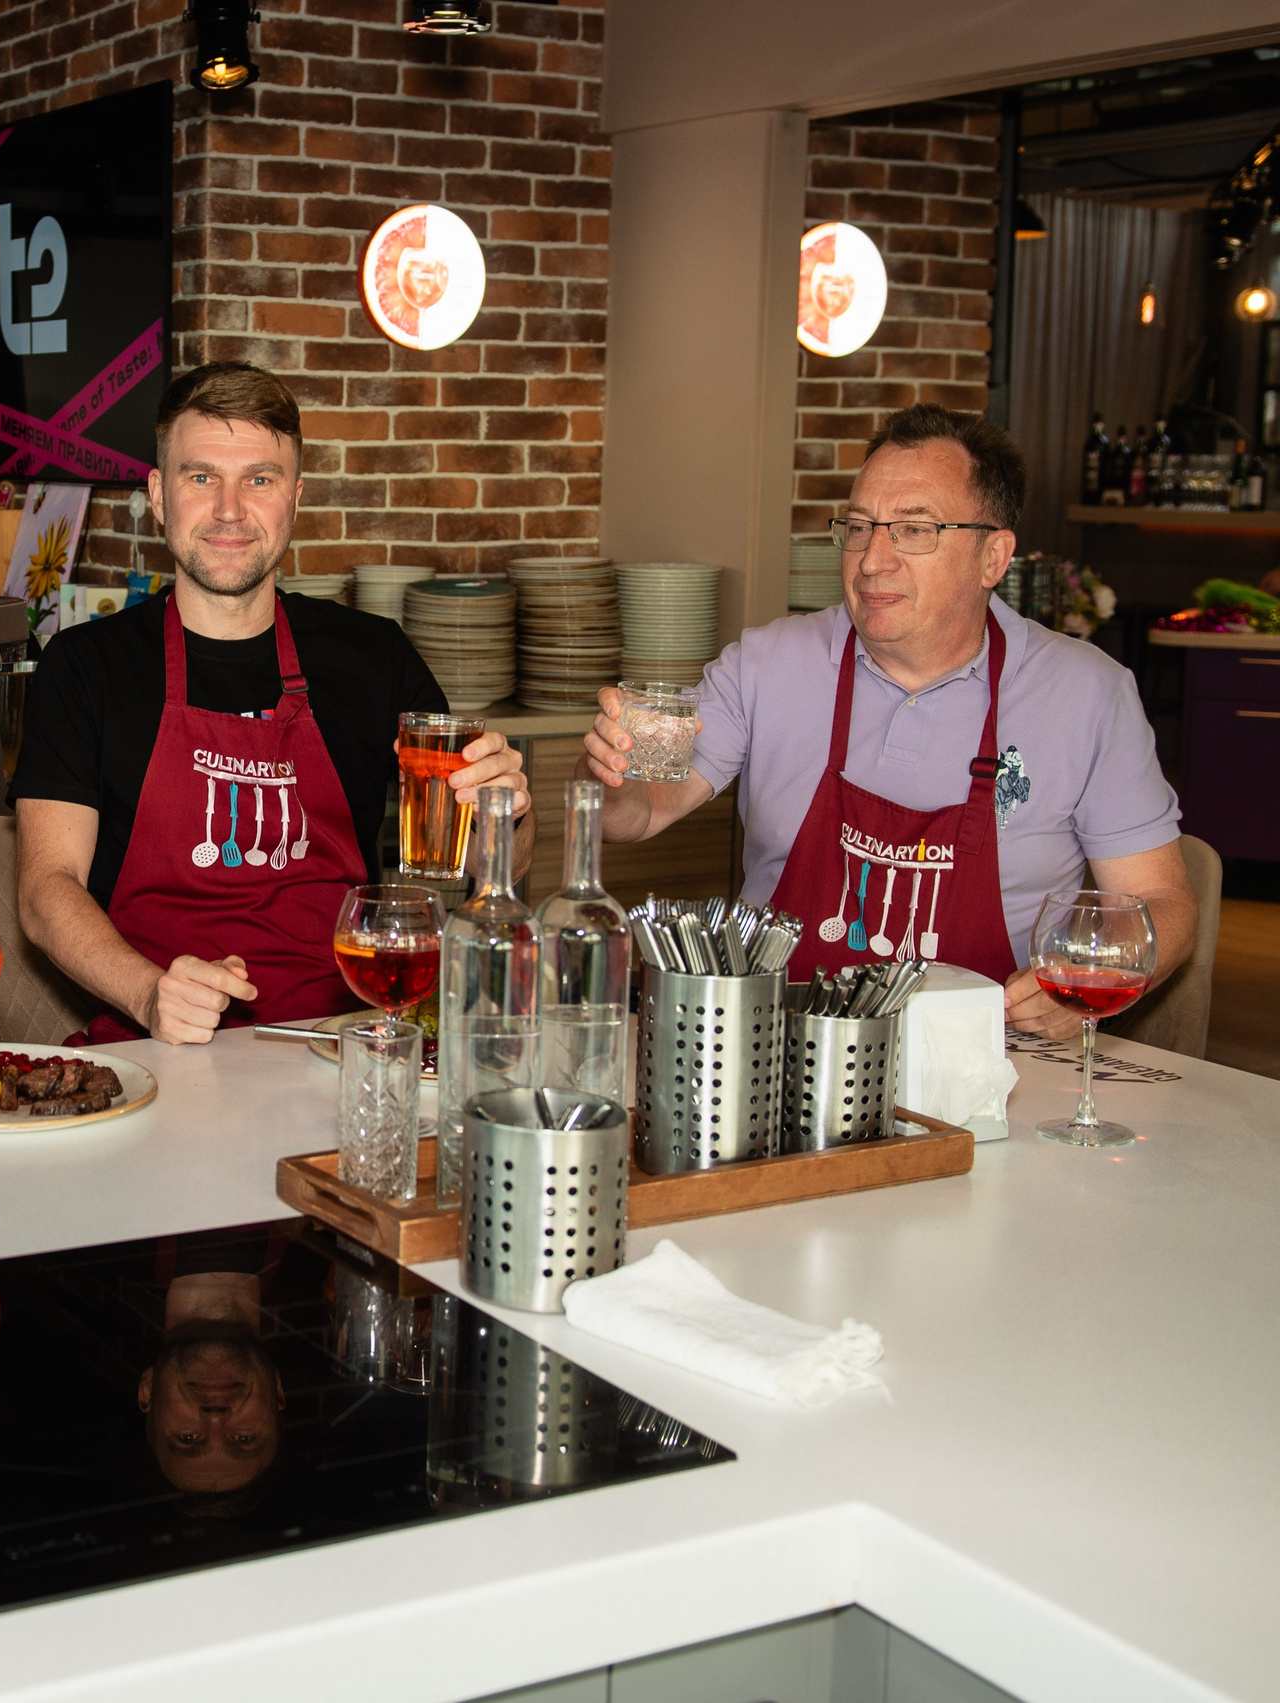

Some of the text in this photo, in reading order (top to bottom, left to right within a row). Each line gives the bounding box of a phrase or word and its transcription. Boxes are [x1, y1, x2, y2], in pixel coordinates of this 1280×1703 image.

[57, 346, 152, 431] ame of Taste:
[1, 413, 53, 452] МЕНЯЕМ
[58, 438, 120, 479] ПРАВИЛА
